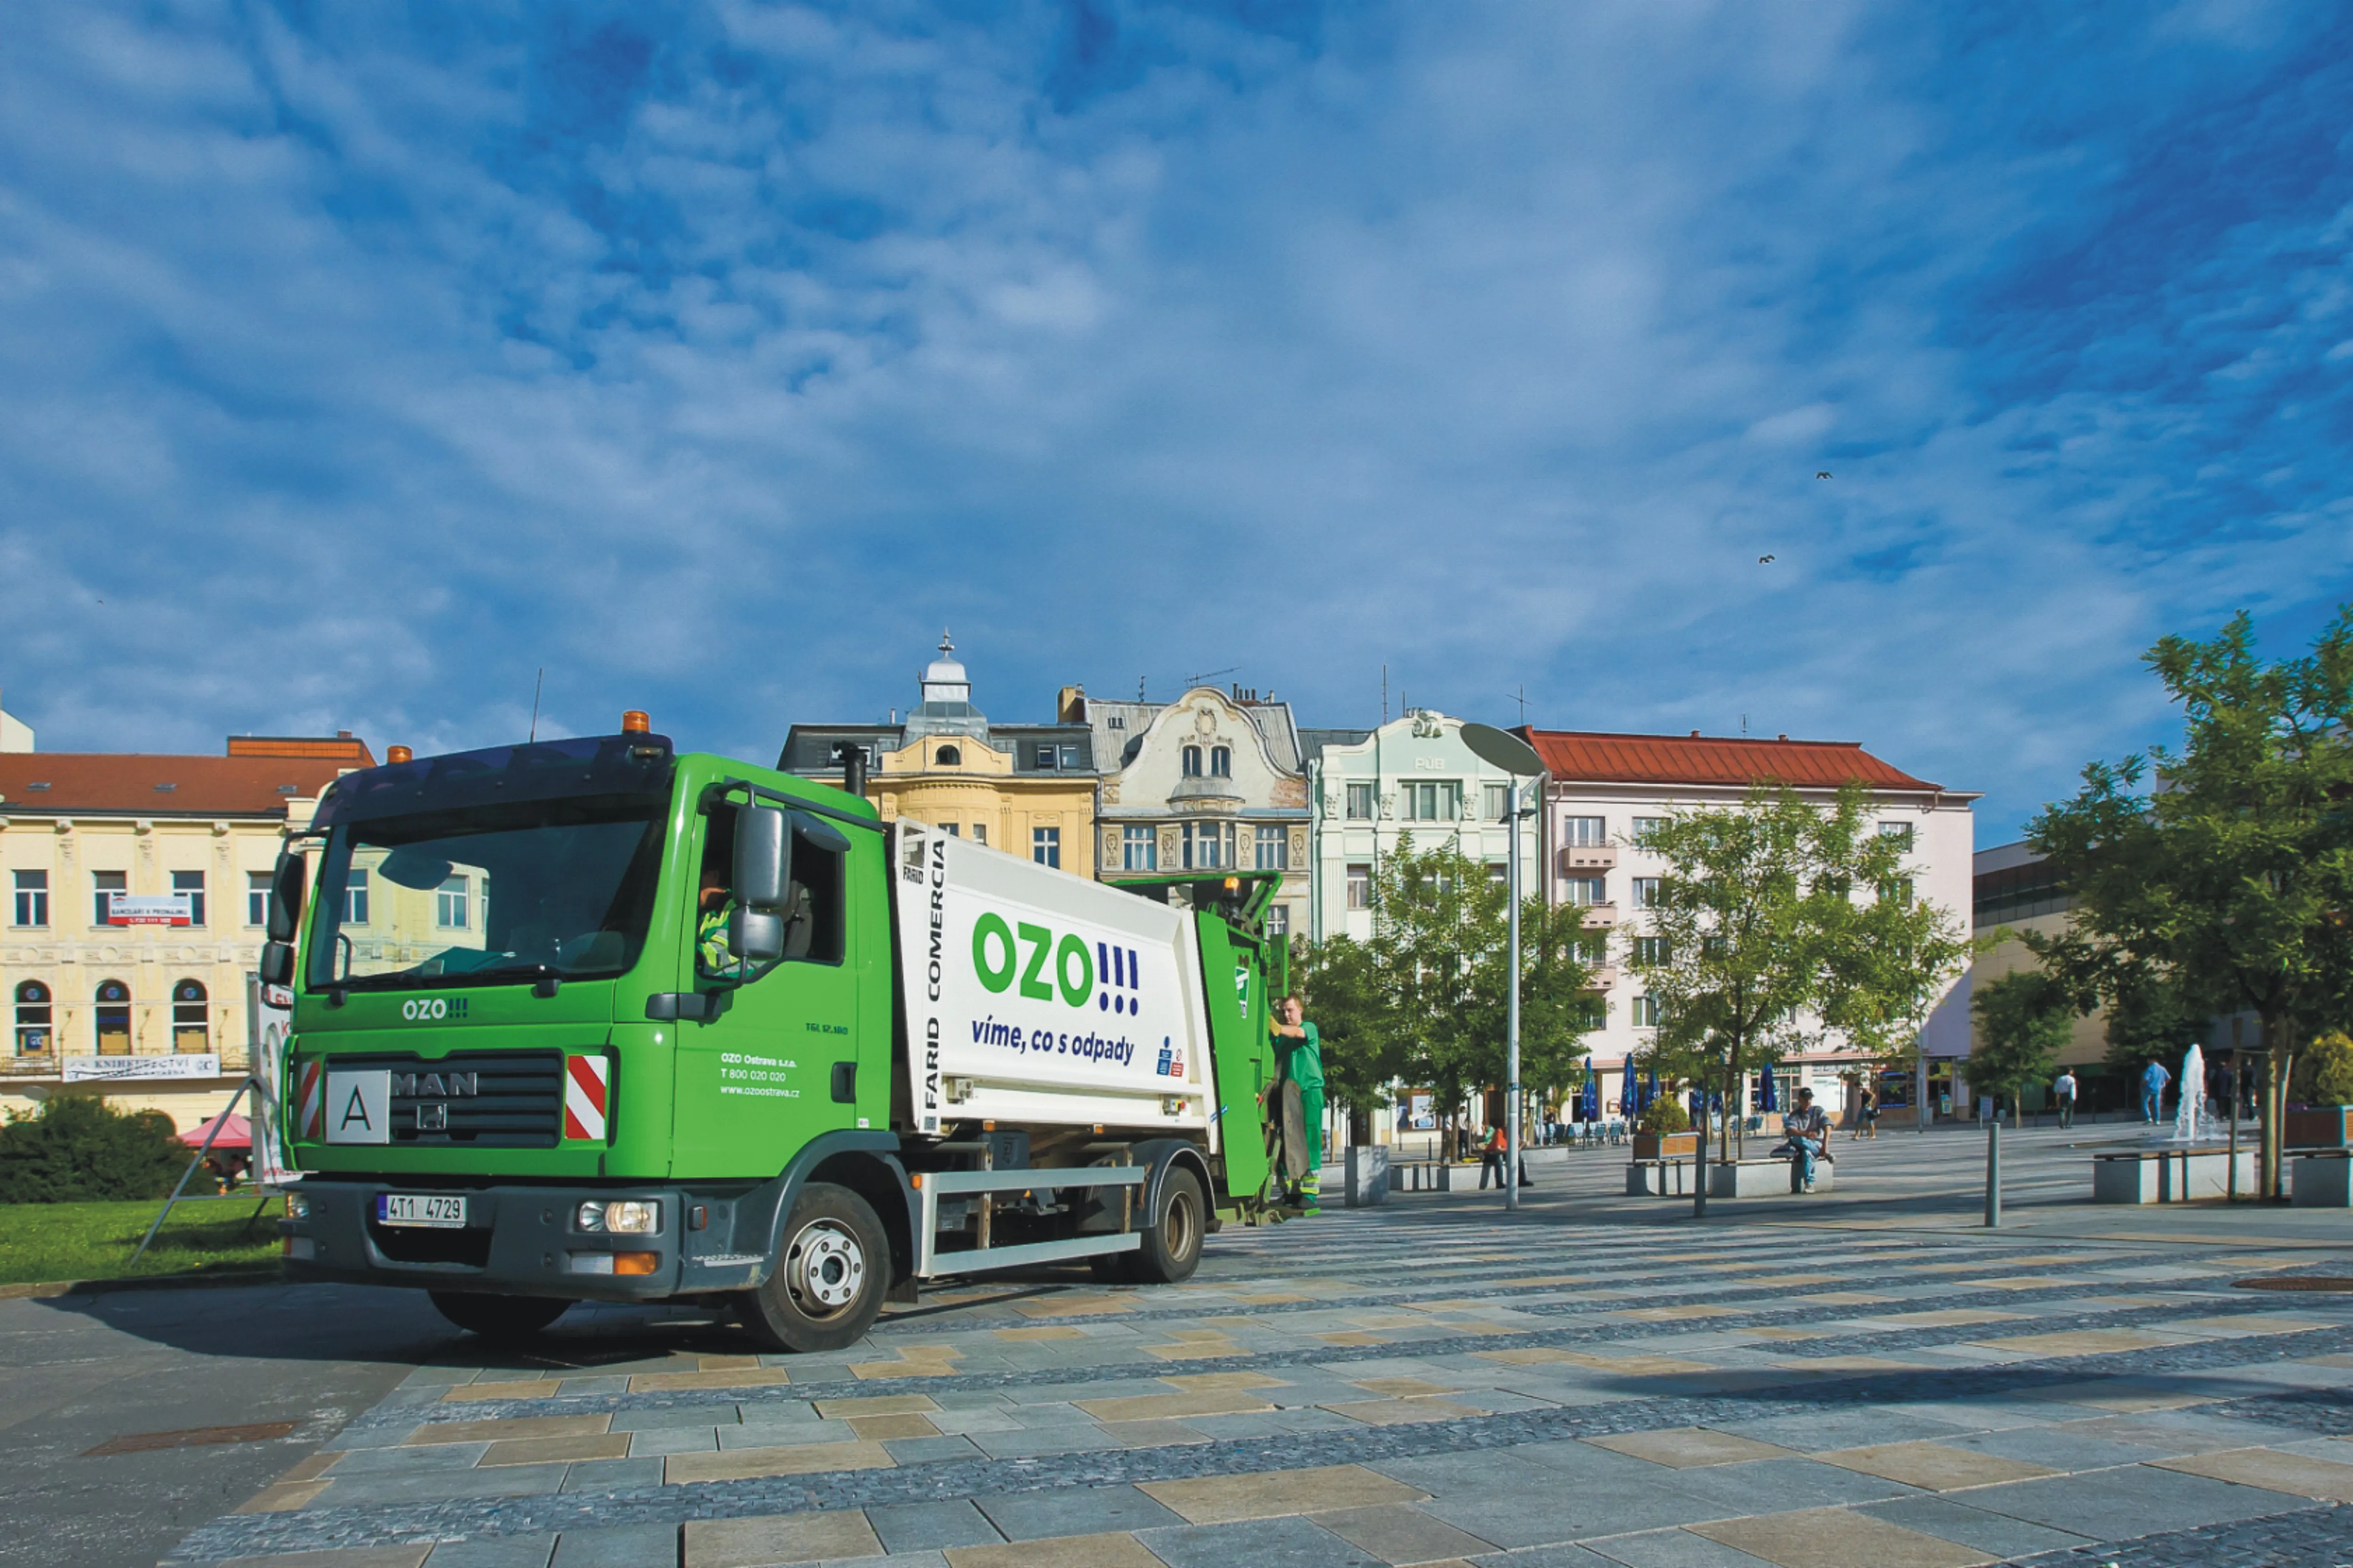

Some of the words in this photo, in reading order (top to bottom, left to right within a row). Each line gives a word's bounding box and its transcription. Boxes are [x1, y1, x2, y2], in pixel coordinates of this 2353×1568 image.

[928, 840, 944, 1002] COMERCIA
[972, 912, 1138, 1016] OZO!!!
[402, 998, 468, 1020] OZO!!!
[972, 1015, 1026, 1054] víme,
[1031, 1030, 1054, 1052] co
[1058, 1033, 1068, 1054] s
[1072, 1031, 1135, 1066] odpady
[721, 1053, 742, 1064] OZO
[744, 1055, 776, 1066] Ostrava
[778, 1059, 797, 1067] s.r.o.
[926, 1017, 939, 1109] FARID
[391, 1072, 477, 1096] MAN
[720, 1068, 728, 1078] T
[729, 1069, 748, 1080] 800
[751, 1071, 767, 1081] 020
[769, 1072, 786, 1082] 020
[720, 1086, 800, 1098] www.ozoostrava.cz
[340, 1084, 371, 1131] A
[390, 1198, 414, 1218] 4T1
[426, 1198, 460, 1219] 4729
